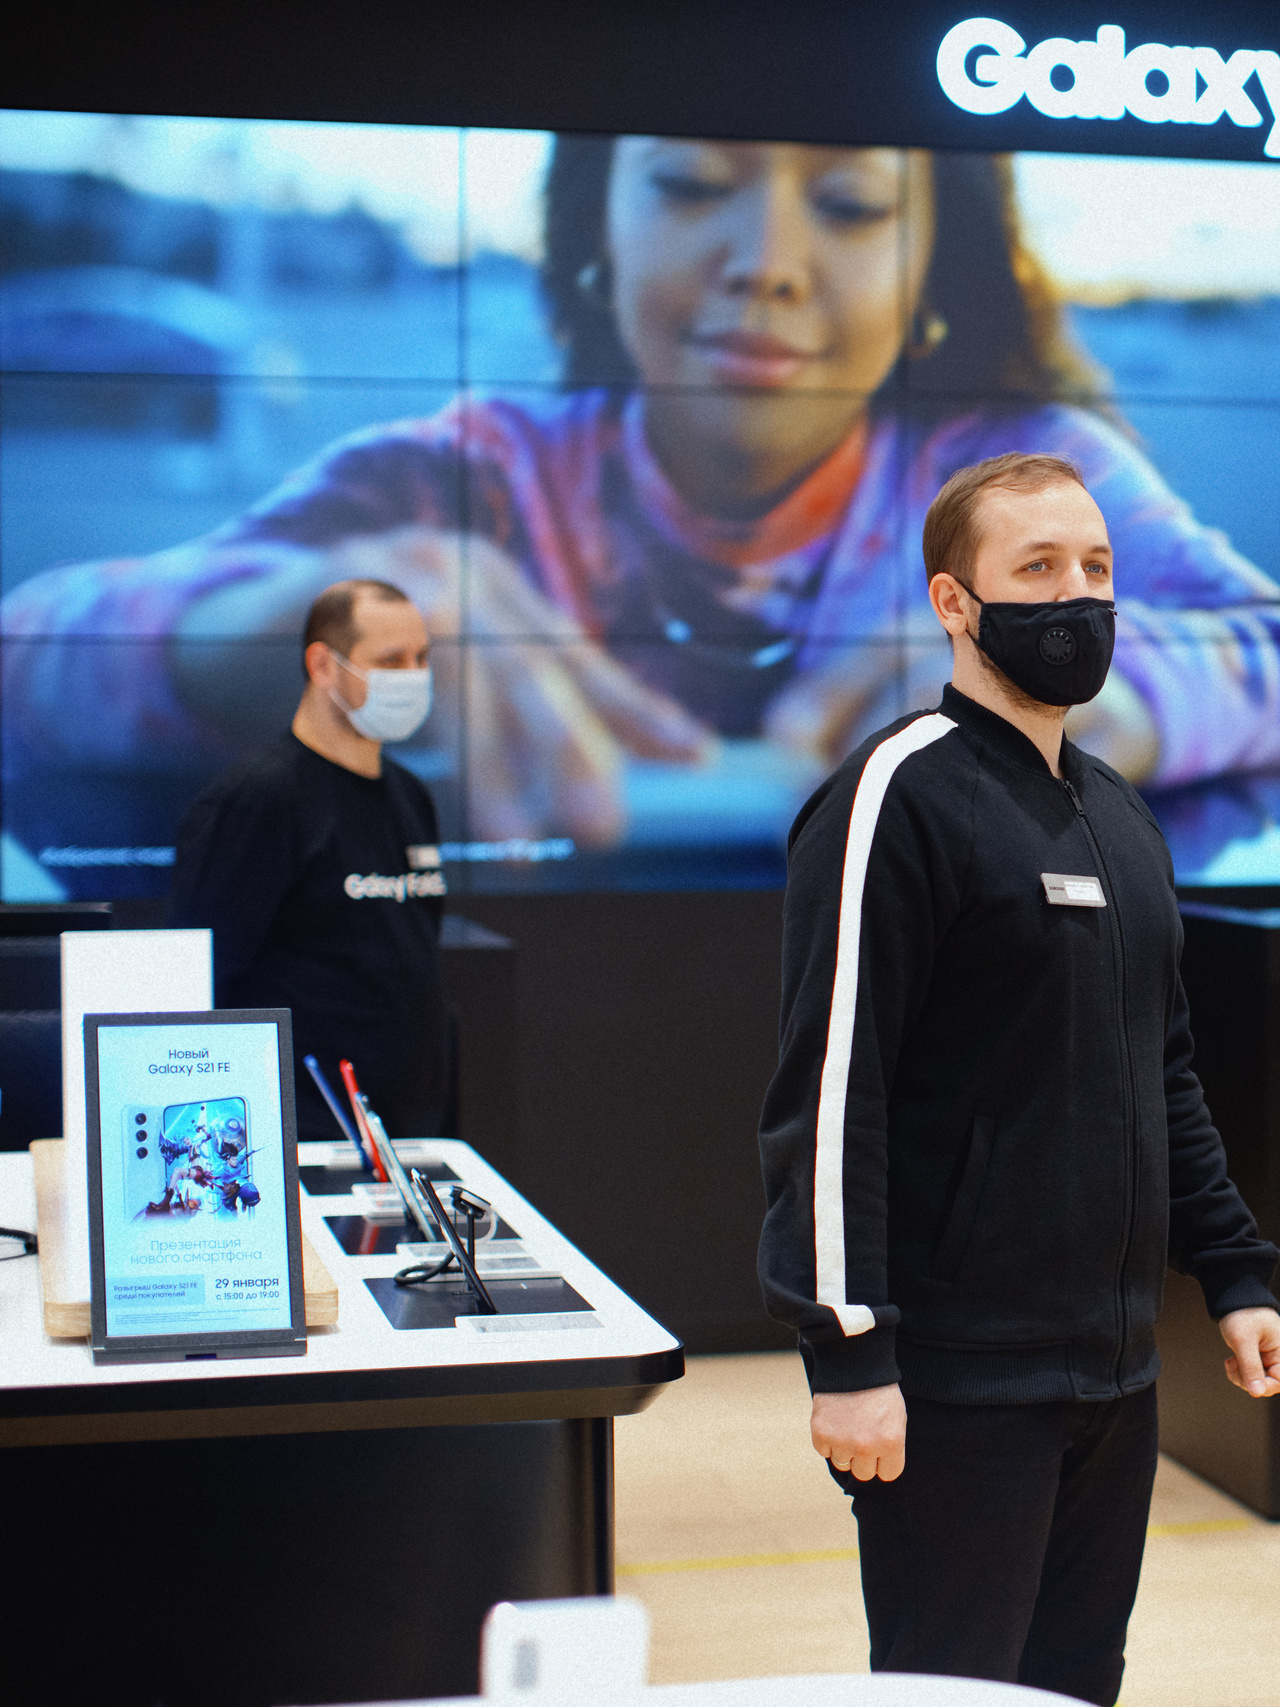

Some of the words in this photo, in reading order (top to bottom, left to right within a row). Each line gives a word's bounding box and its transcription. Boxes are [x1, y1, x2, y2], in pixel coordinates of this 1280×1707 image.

[168, 1047, 209, 1060] Новый
[148, 1063, 194, 1077] Galaxy
[196, 1062, 215, 1073] S21
[217, 1062, 230, 1073] FE
[150, 1238, 241, 1254] Презентация
[130, 1253, 180, 1265] нового
[183, 1249, 262, 1264] смартфона
[152, 1283, 177, 1291] Galaxy
[215, 1278, 230, 1289] 29
[232, 1277, 280, 1290] января
[215, 1293, 222, 1301] с
[223, 1291, 244, 1300] 15:00
[245, 1292, 258, 1300] до
[259, 1290, 280, 1299] 19:00
